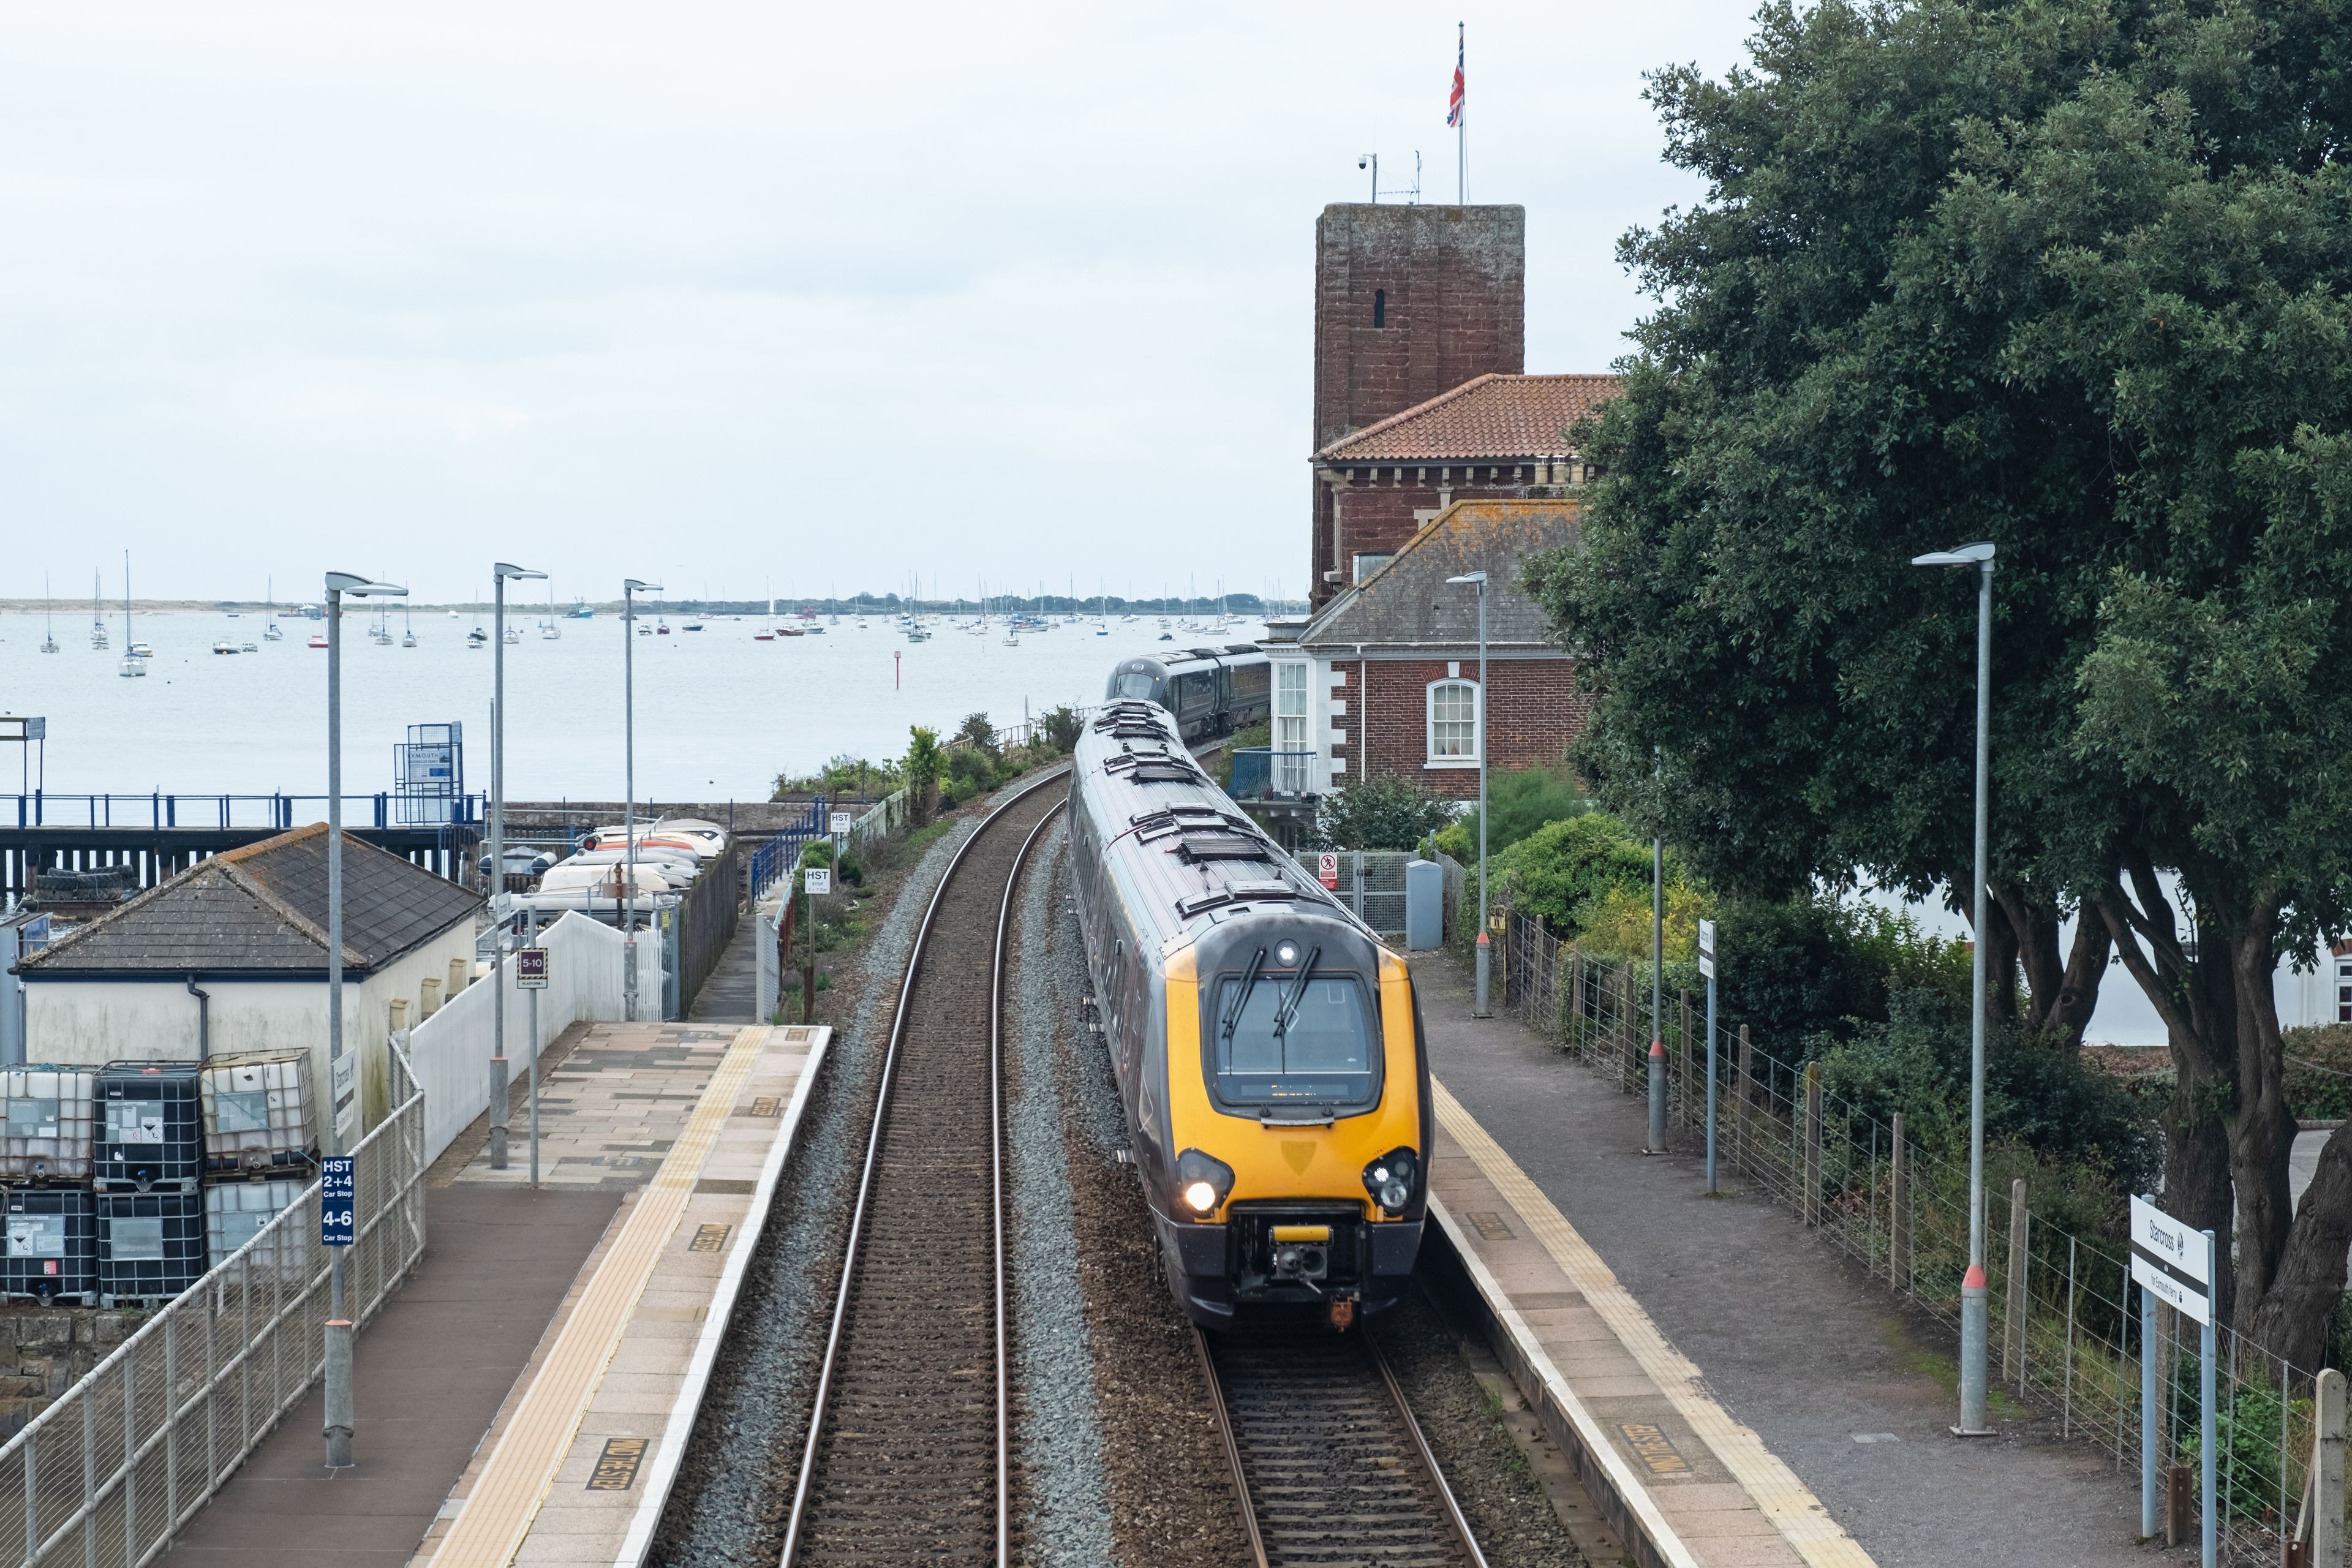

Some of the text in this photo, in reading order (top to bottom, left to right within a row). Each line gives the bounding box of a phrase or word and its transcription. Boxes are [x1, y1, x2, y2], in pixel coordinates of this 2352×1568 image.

[807, 871, 828, 880] HST
[522, 959, 542, 967] 5-10
[323, 1161, 352, 1172] HST
[323, 1175, 352, 1187] 2+4
[323, 1211, 352, 1226] 4-6
[2150, 1219, 2174, 1251] Starcross
[2156, 1276, 2169, 1294] Exmouth
[1621, 1425, 1664, 1442] STEP
[1634, 1441, 1675, 1455] THE
[600, 1457, 638, 1469] THE
[591, 1471, 631, 1490] STEP
